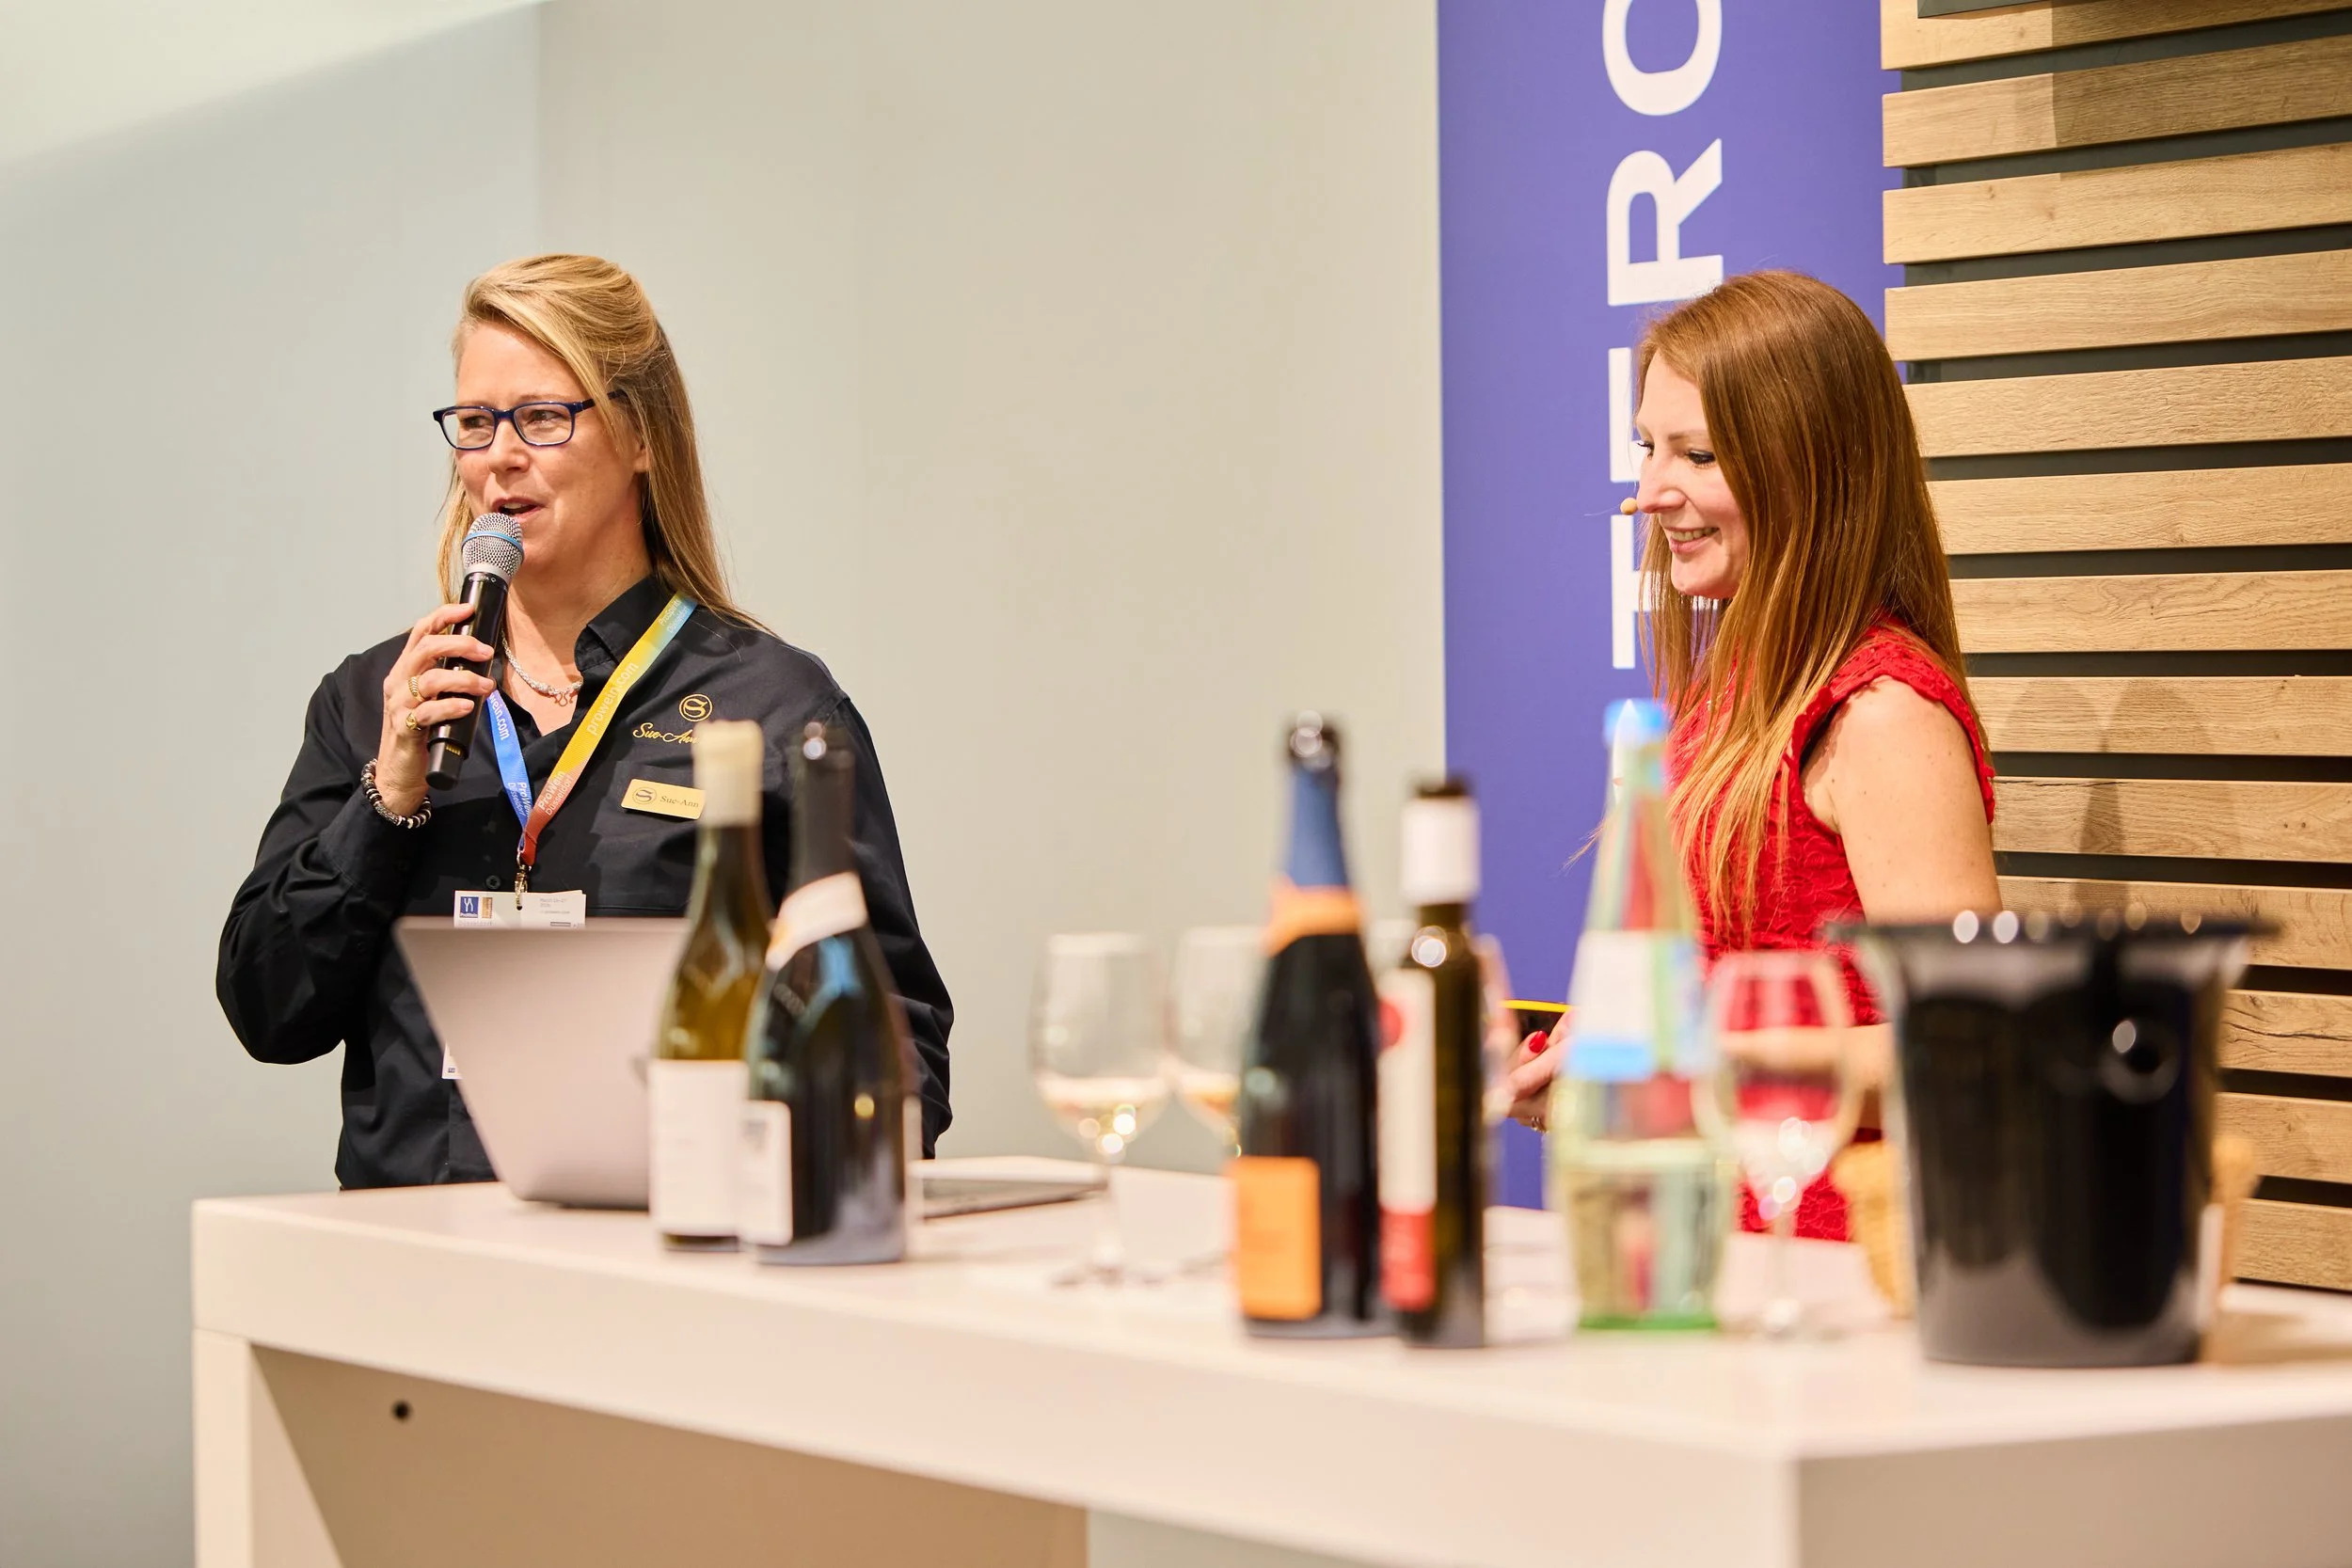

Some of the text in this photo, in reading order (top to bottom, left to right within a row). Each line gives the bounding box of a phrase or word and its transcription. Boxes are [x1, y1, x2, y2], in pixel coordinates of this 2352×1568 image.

[585, 660, 639, 737] prowein.com
[537, 770, 566, 811] ProWein
[660, 794, 699, 808] Sue-Ann
